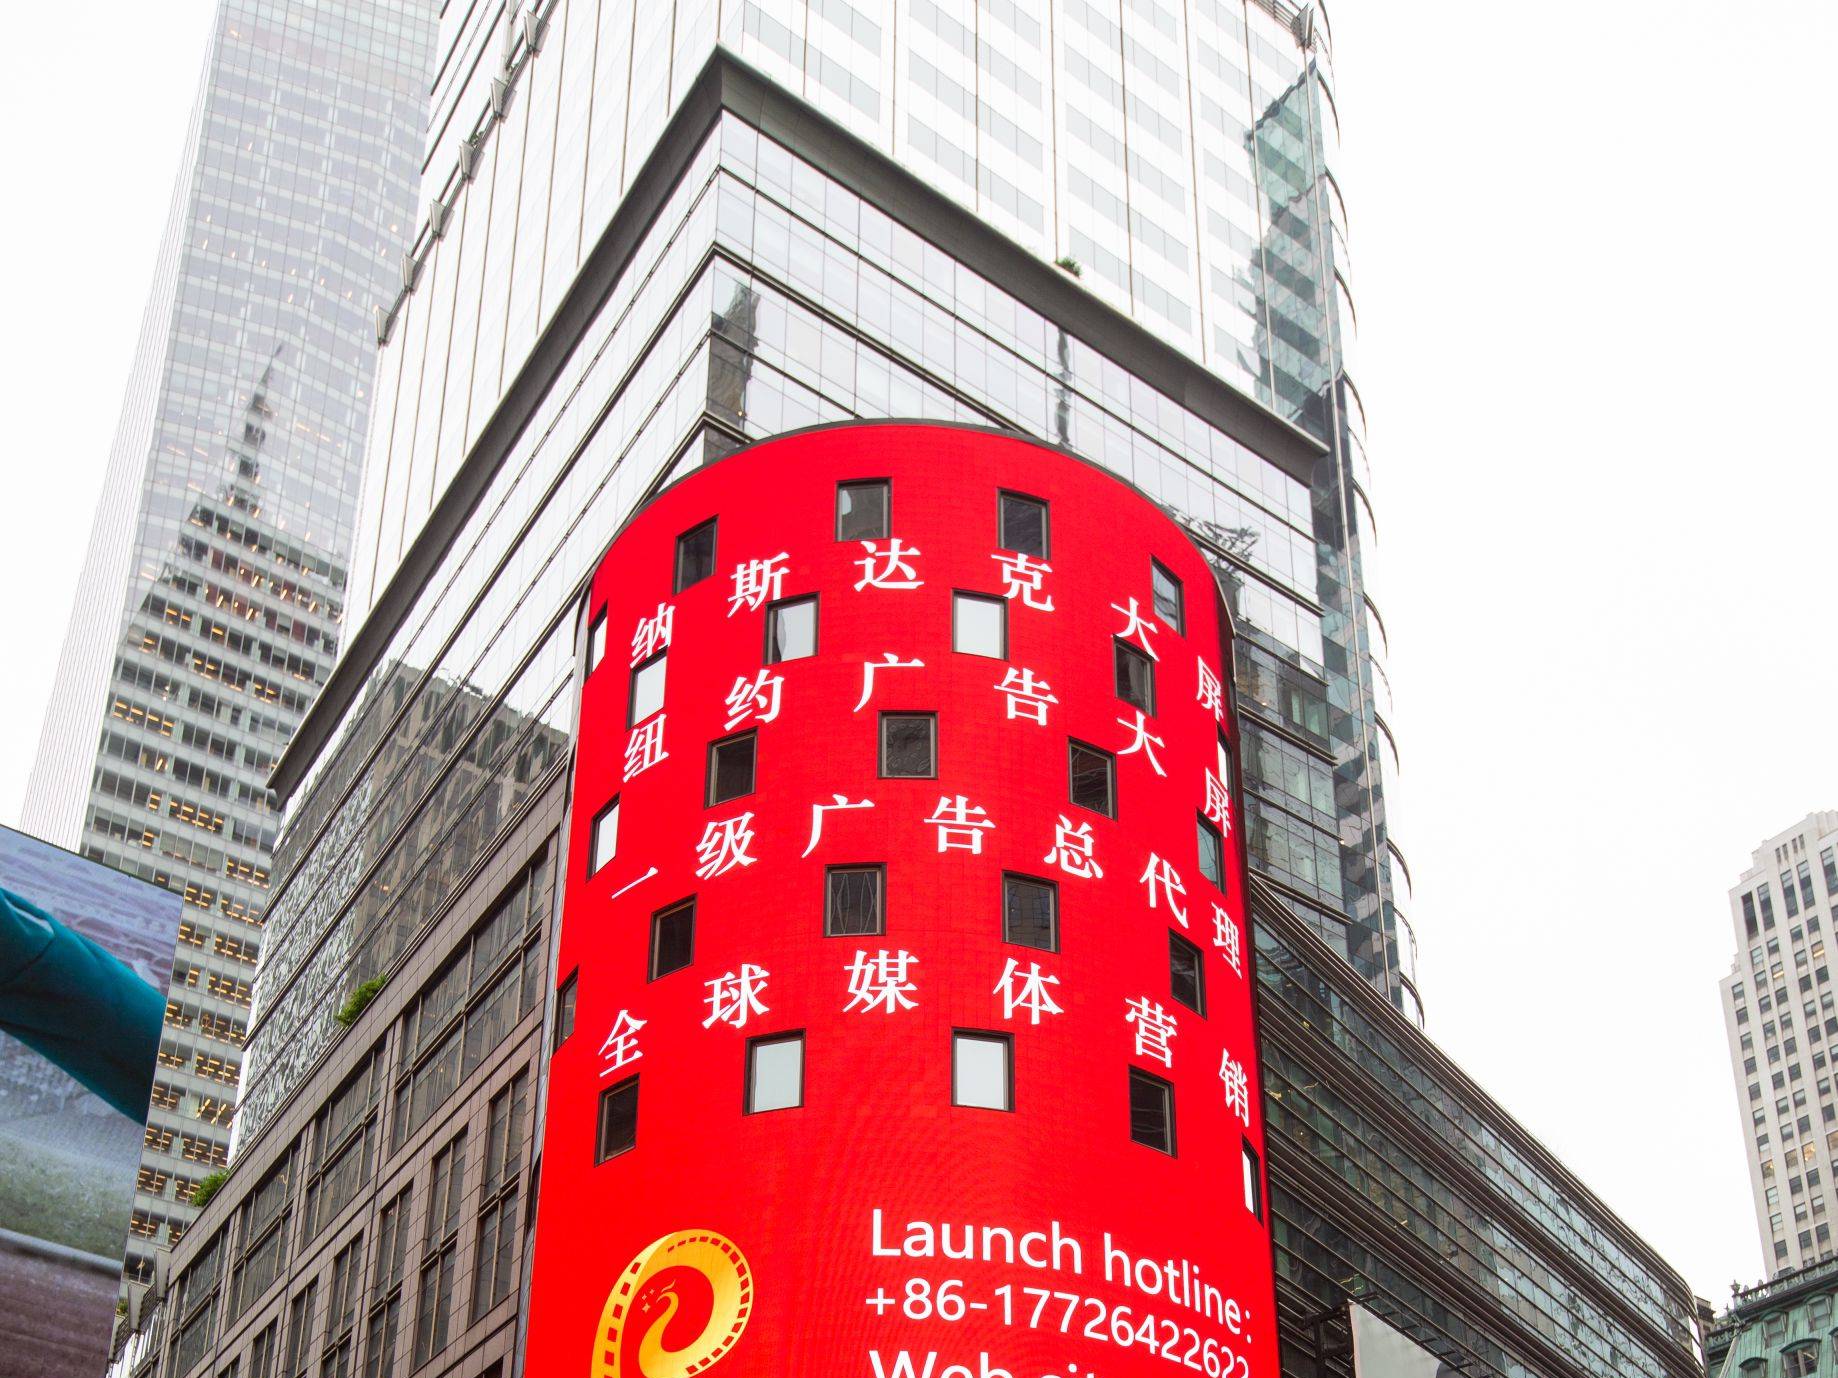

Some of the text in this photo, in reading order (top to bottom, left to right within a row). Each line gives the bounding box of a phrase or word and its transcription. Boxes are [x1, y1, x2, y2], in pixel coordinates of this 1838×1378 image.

[629, 538, 1224, 722] 纳斯达克大屏
[622, 653, 1231, 839] 纽约广告大屏
[611, 794, 1243, 979] 一级广告总代理
[599, 949, 1250, 1128] 全球媒体营销
[872, 1208, 1252, 1344] Launch hotline:
